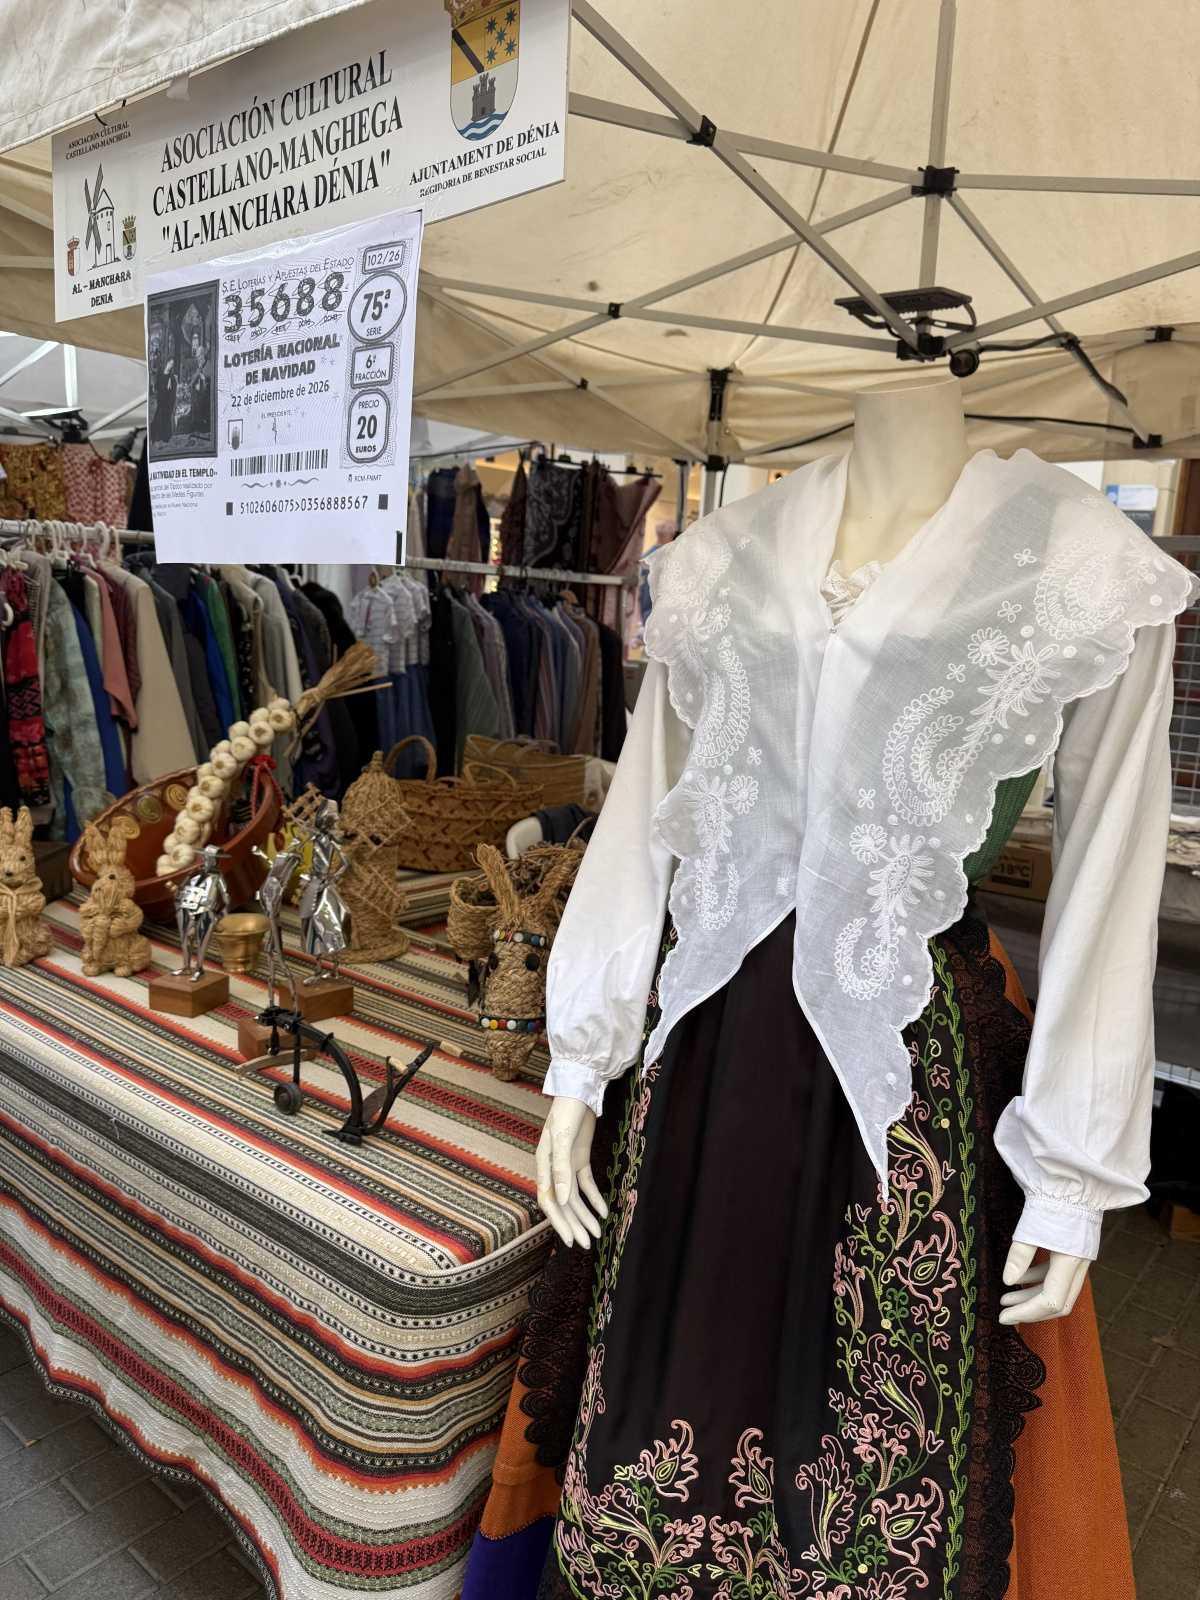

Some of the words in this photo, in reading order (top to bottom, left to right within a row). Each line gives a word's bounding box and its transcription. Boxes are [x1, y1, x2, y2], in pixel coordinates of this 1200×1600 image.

[160, 96, 275, 173] ASOCIACIÓN
[280, 49, 393, 126] CULTURAL
[152, 95, 403, 217] CASTELLANO-MANGHEGA
[409, 144, 493, 186] AJUNTAMENT
[496, 136, 514, 156] DE
[517, 120, 560, 148] DÉNIA
[462, 172, 473, 183] DE
[474, 158, 515, 182] BENESTAR
[516, 147, 547, 166] SOCIAL
[162, 180, 310, 253] "AL-MANCHARA
[313, 149, 391, 209] DÉNIA"
[275, 267, 308, 281] APUESTAS
[309, 264, 321, 273] DEL
[323, 257, 355, 270] ESTADO
[367, 250, 400, 266] 102/26
[72, 284, 83, 295] AL
[89, 270, 132, 290] MANCHARA
[90, 292, 114, 307] DENIA
[223, 271, 345, 334] 35688
[366, 326, 382, 337] SERIE
[223, 343, 274, 369] LOTERÍA
[277, 333, 341, 359] NACIONAL
[245, 370, 259, 386] DE
[261, 359, 316, 383] NAVIDAD
[355, 368, 387, 381] FRACCIÓN
[231, 395, 242, 408] 22
[243, 393, 253, 405] de
[254, 387, 295, 404] diciembre
[295, 384, 306, 396] de
[308, 380, 330, 395] 2026
[358, 399, 380, 409] PRECIO
[356, 414, 378, 440] 20
[355, 444, 377, 454] EUROS
[181, 469, 188, 478] EL
